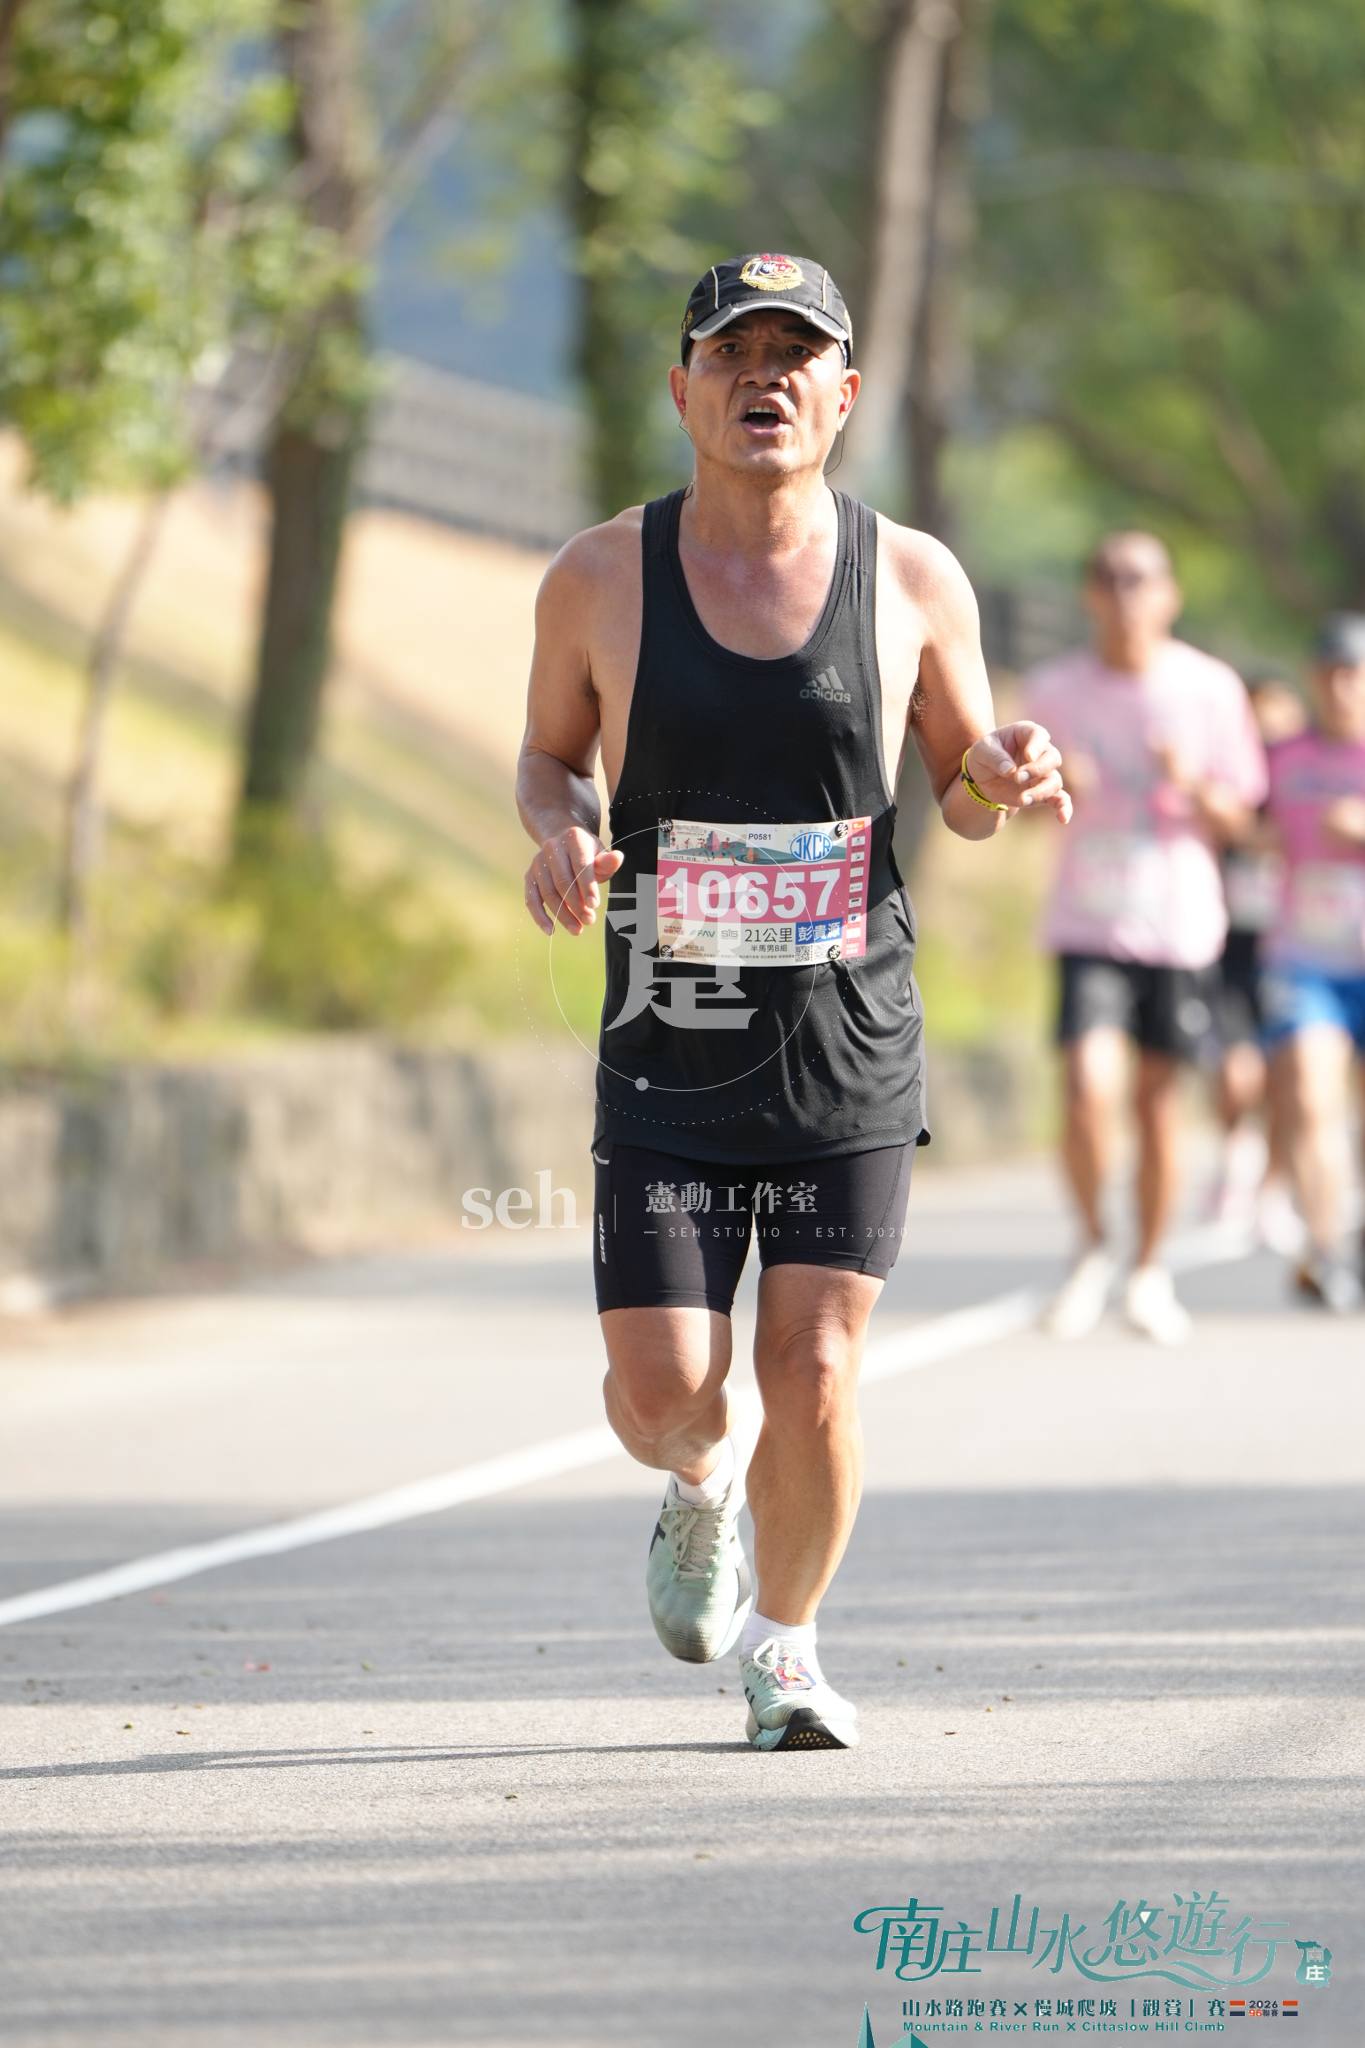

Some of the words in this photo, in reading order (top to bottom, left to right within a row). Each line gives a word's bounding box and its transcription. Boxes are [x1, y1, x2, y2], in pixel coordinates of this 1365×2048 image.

[800, 686, 852, 703] adidas
[748, 833, 772, 841] P0581
[664, 867, 841, 919] 10657
[744, 927, 793, 943] 21公里
